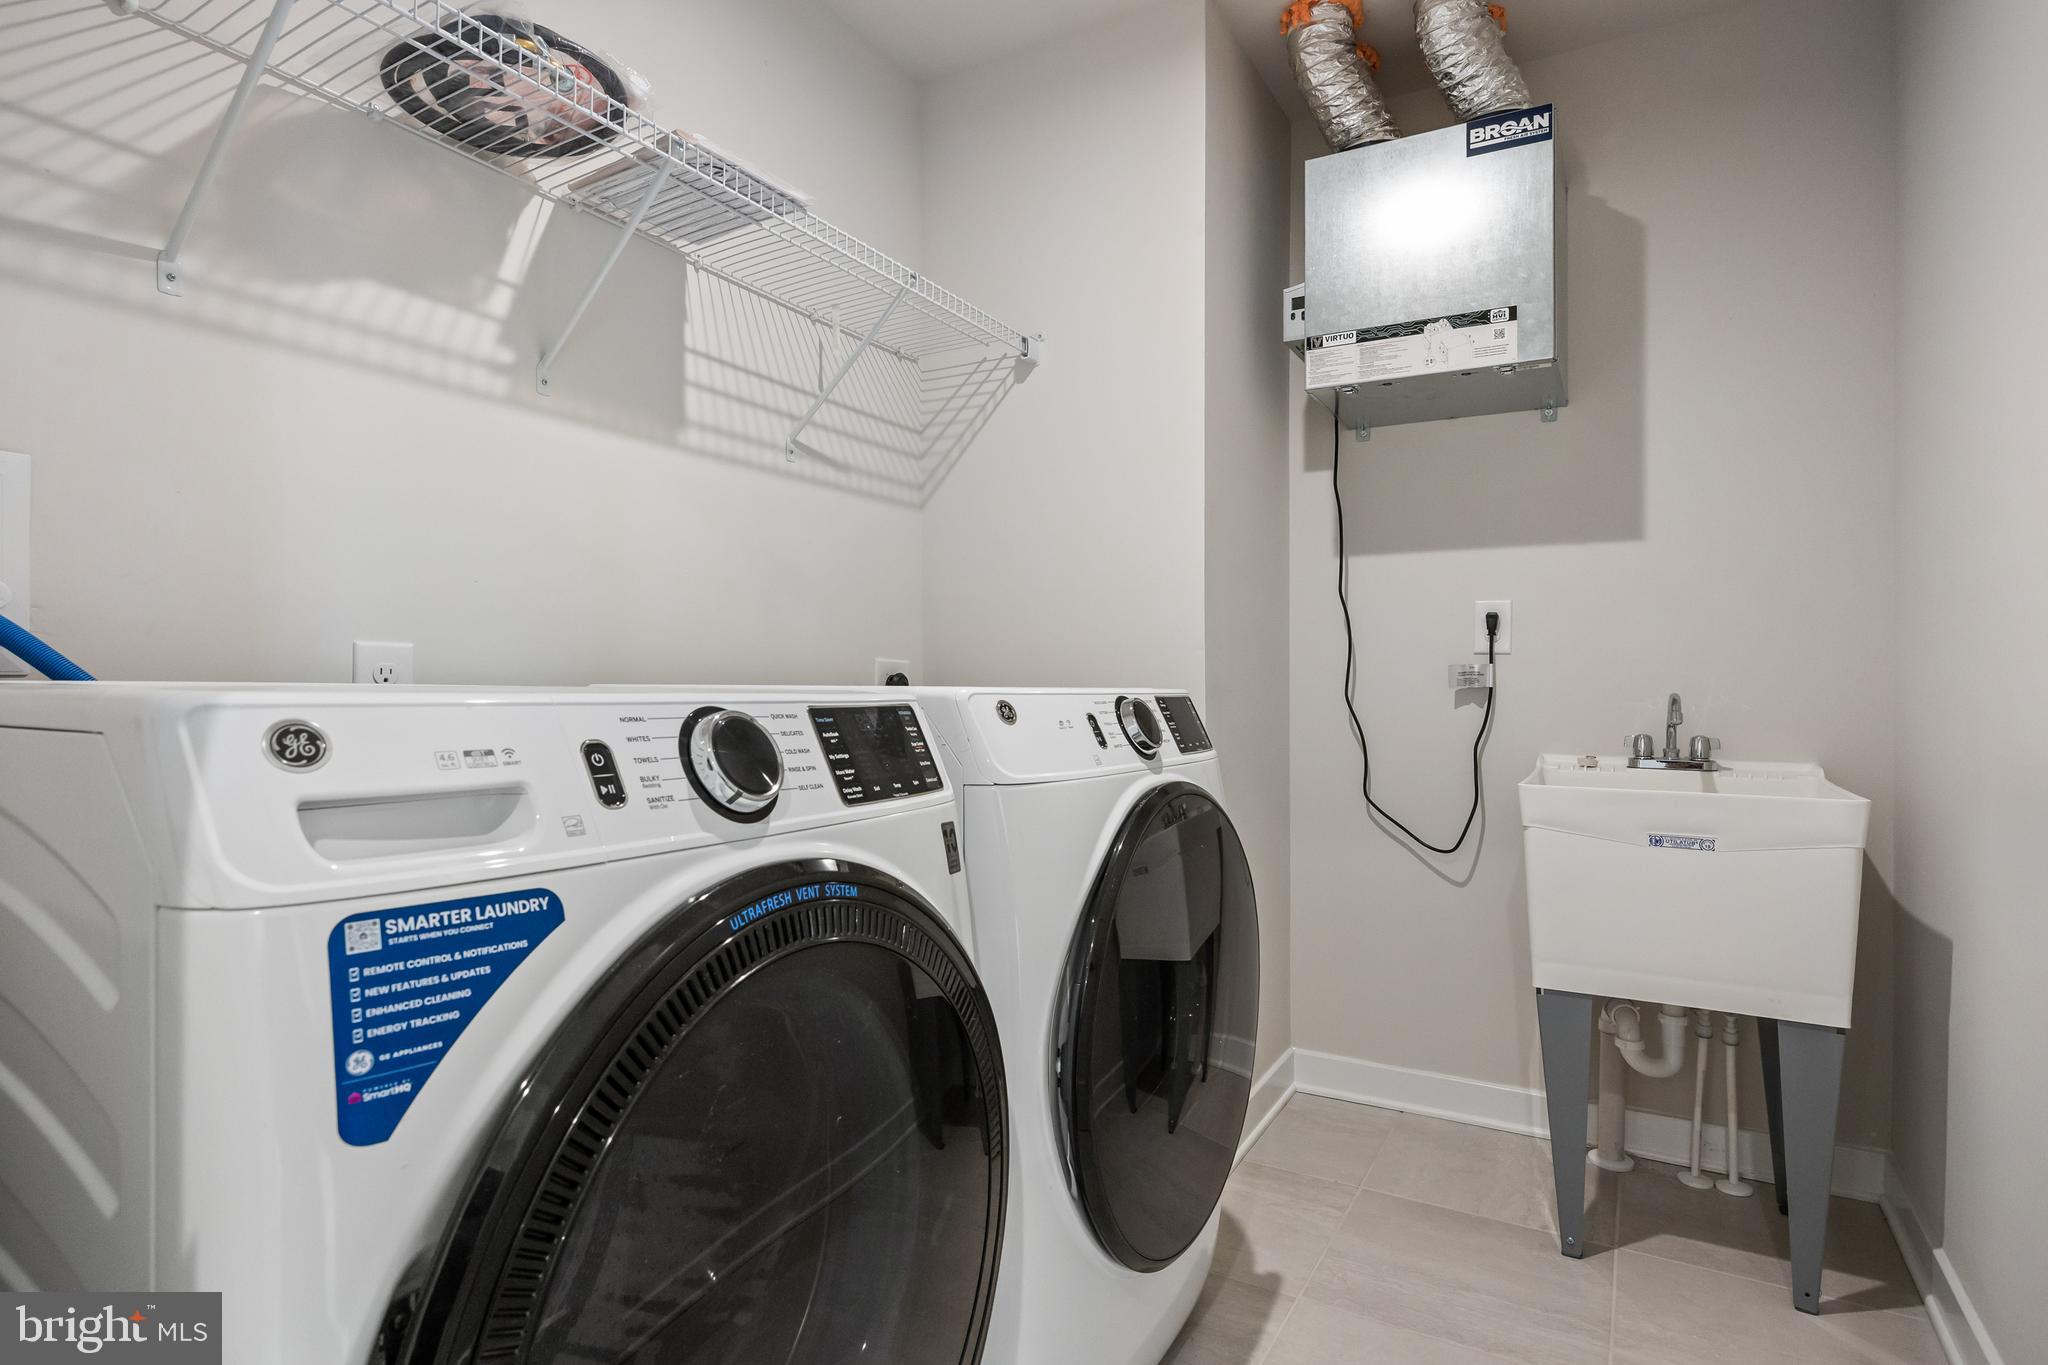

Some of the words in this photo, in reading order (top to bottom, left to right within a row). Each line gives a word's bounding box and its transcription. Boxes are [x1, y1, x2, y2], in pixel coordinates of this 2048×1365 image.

[1470, 112, 1550, 144] BROAN
[1325, 332, 1354, 342] VIRTUO
[646, 795, 674, 804] SANITIZE
[385, 909, 471, 935] SMARTER
[475, 897, 550, 921] LAUNDRY
[730, 892, 792, 930] ULTRAFRESH
[796, 884, 820, 901] VENT
[824, 884, 858, 898] SYSTEM
[388, 932, 418, 946] STARTS
[418, 930, 442, 940] WHEN
[443, 926, 460, 937] YOU
[460, 922, 494, 935] CONNECT
[363, 958, 405, 977] REMOTE
[406, 952, 453, 970] CONTROL
[454, 951, 462, 960] &
[463, 940, 528, 958] NOTIFICATIONS
[364, 984, 390, 998] NEW
[391, 974, 440, 993] FEATURES
[440, 973, 449, 983] &
[450, 966, 491, 982] UPDATES
[366, 998, 422, 1018] ENHANCED
[424, 988, 472, 1006] CLEANING
[366, 1022, 408, 1039] ENERGY
[409, 1010, 460, 1029] TRACKING
[392, 1040, 443, 1058] APPLIANCES
[362, 1082, 412, 1102] SmartHQ
